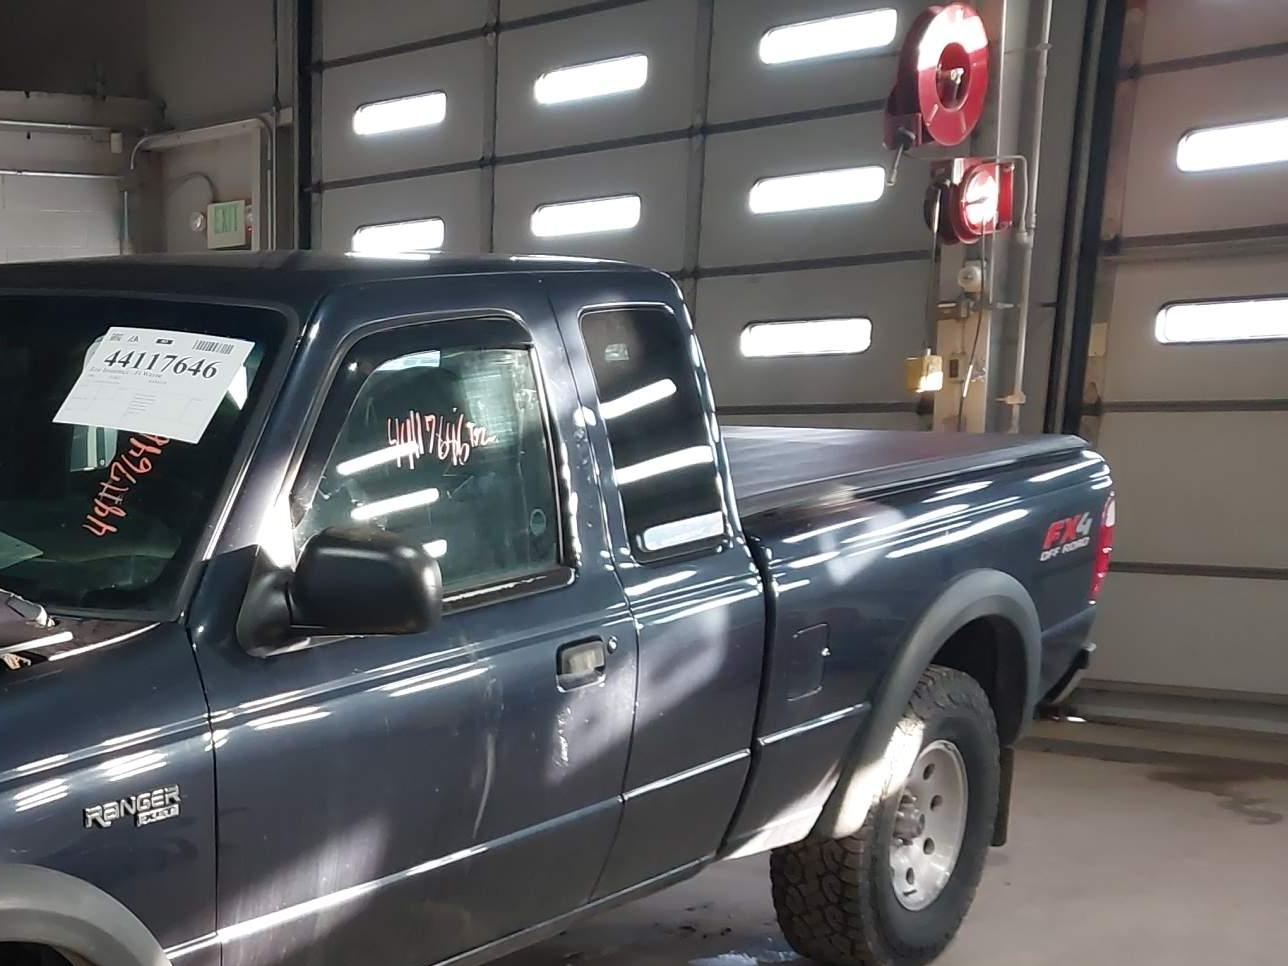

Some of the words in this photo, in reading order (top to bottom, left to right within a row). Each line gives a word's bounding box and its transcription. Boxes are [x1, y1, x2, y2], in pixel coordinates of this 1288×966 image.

[214, 206, 240, 233] EXIT
[104, 349, 222, 378] 44117646
[1042, 512, 1093, 550] FX4
[85, 785, 181, 828] RANGER
